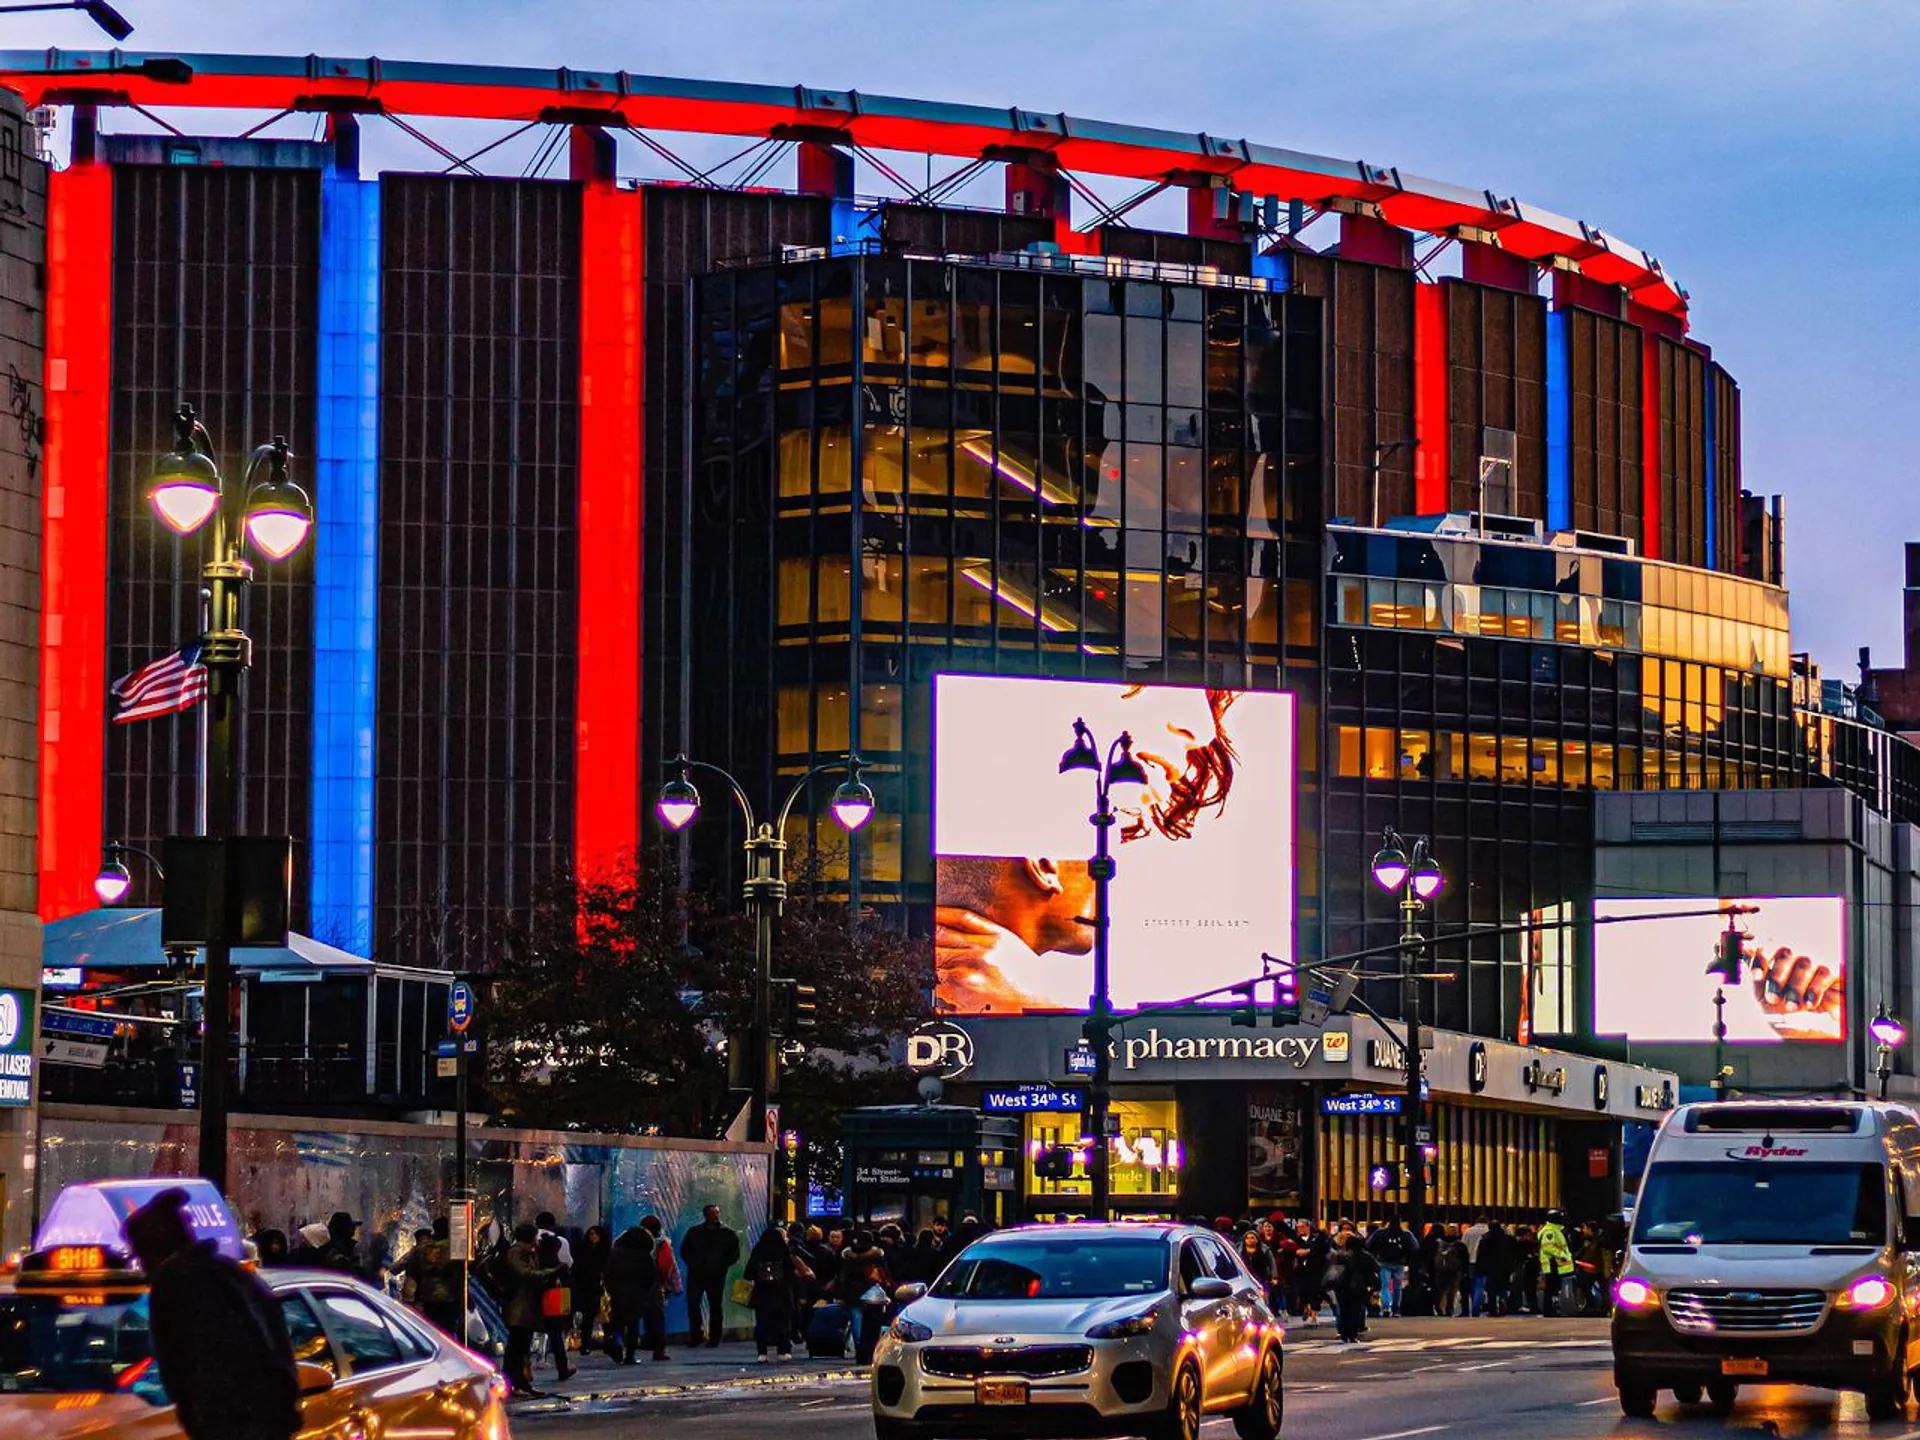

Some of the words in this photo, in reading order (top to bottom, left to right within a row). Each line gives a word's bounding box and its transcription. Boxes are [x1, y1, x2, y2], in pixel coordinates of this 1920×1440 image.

[908, 1034, 974, 1067] DR
[1124, 1029, 1319, 1070] pharmacy
[6, 1054, 31, 1076] LASER
[989, 1093, 1027, 1107] West
[1030, 1092, 1058, 1107] 34th
[1062, 1092, 1077, 1106] St
[1326, 1100, 1357, 1111] West
[1359, 1099, 1381, 1111] 34th
[1384, 1100, 1396, 1110] St
[1745, 1146, 1808, 1158] Ryder
[856, 1167, 868, 1175] 34
[856, 1175, 877, 1183] Penn
[880, 1175, 910, 1183] Station
